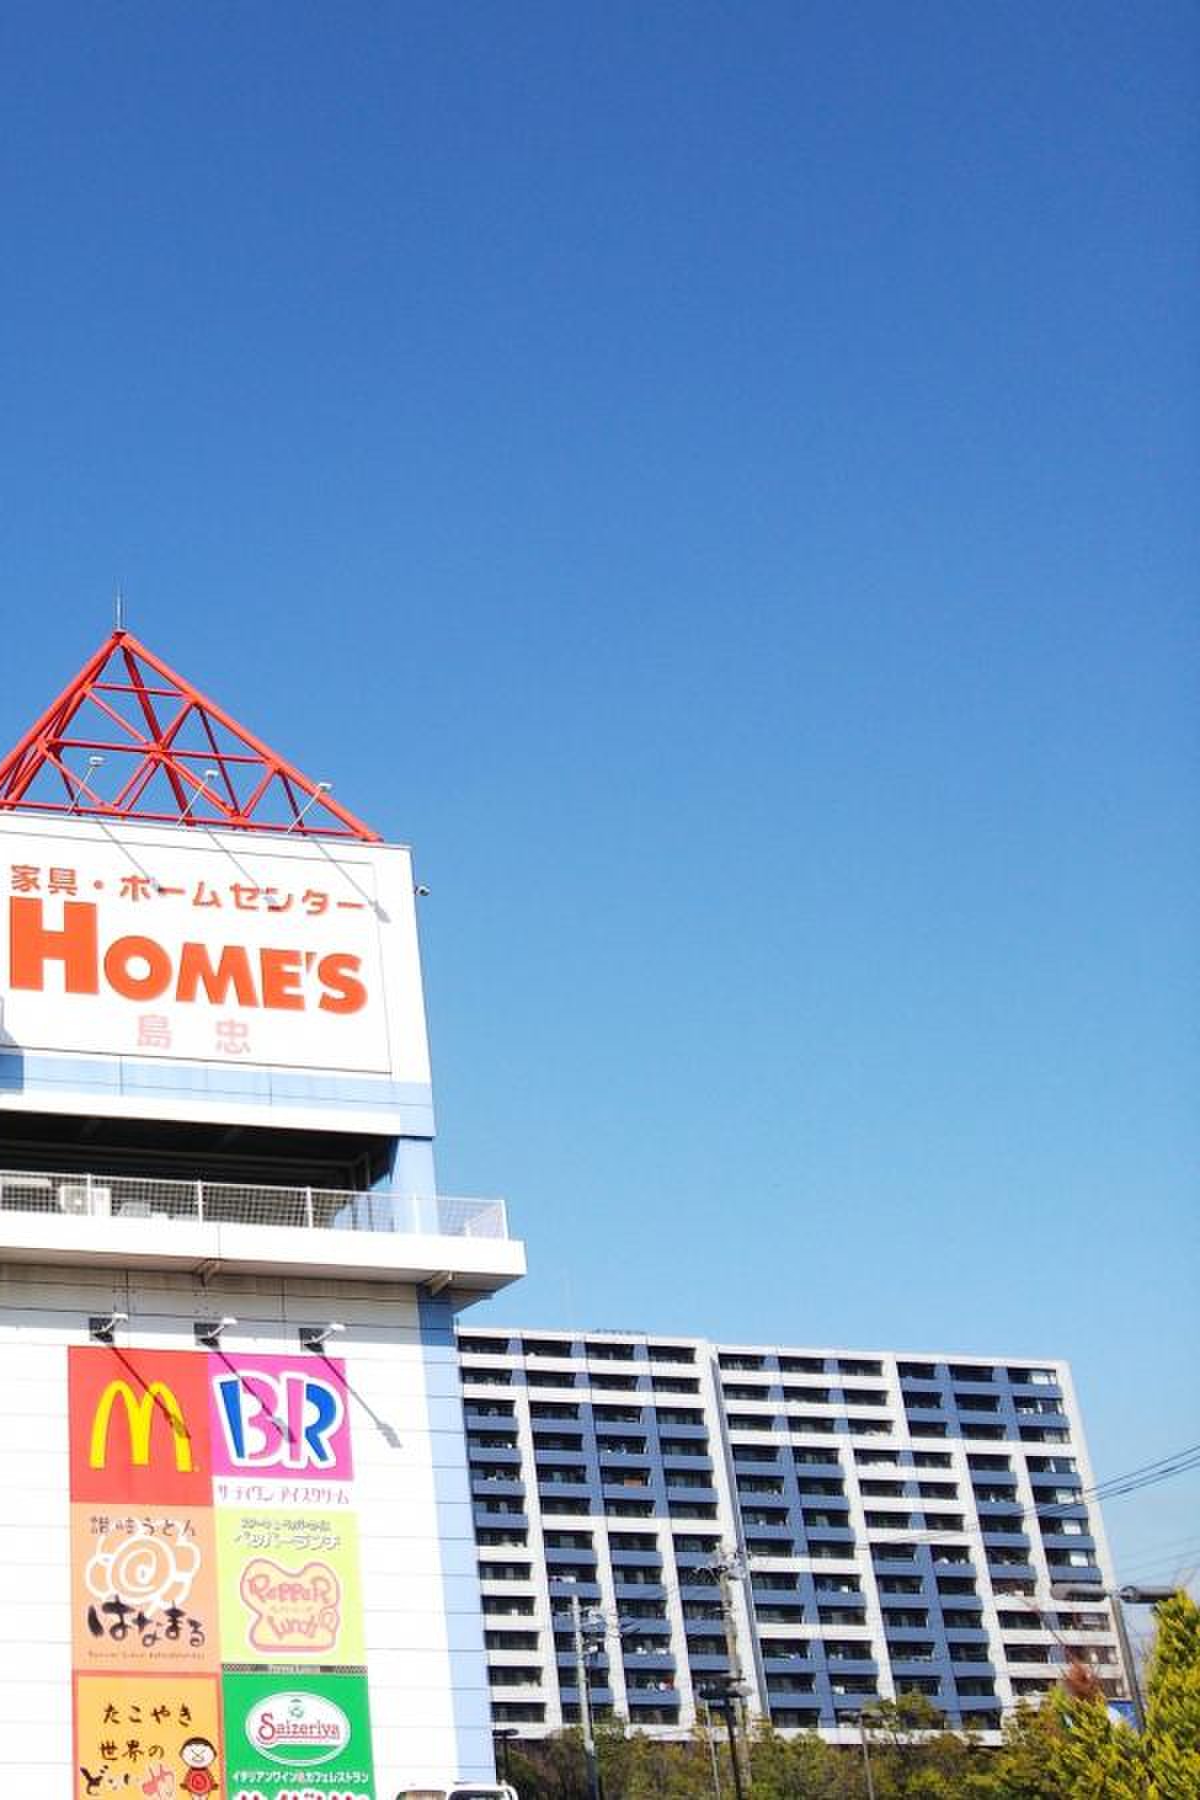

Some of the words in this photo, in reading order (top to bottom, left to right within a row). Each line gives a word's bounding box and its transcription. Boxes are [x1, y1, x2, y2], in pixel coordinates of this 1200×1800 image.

[10, 864, 365, 915] 家具・ホームセンター
[9, 895, 369, 1015] HOME'S
[87, 1594, 206, 1648] はなまる
[102, 1702, 193, 1728] たこやき
[257, 1711, 341, 1743] Saizeriya
[100, 1739, 165, 1762] 世界の
